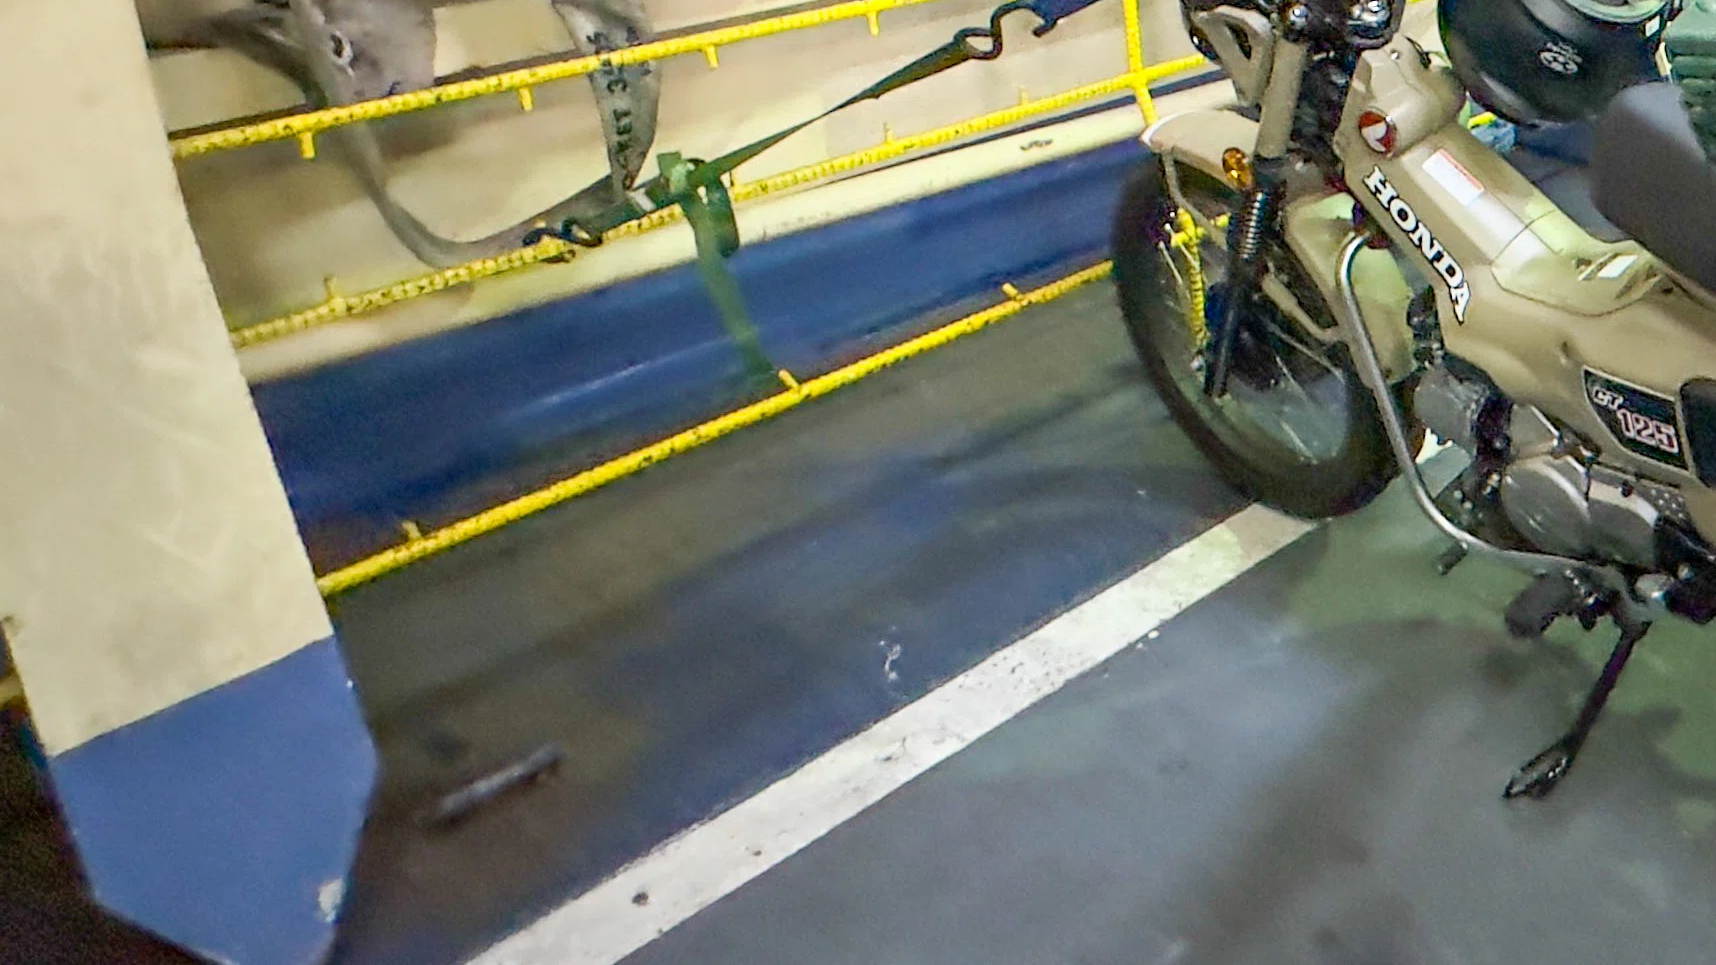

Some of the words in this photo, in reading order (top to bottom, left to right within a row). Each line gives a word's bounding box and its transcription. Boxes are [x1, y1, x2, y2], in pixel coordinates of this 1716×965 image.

[1362, 163, 1471, 326] HONDA
[1592, 386, 1624, 410] CT
[1616, 408, 1679, 454] 125
